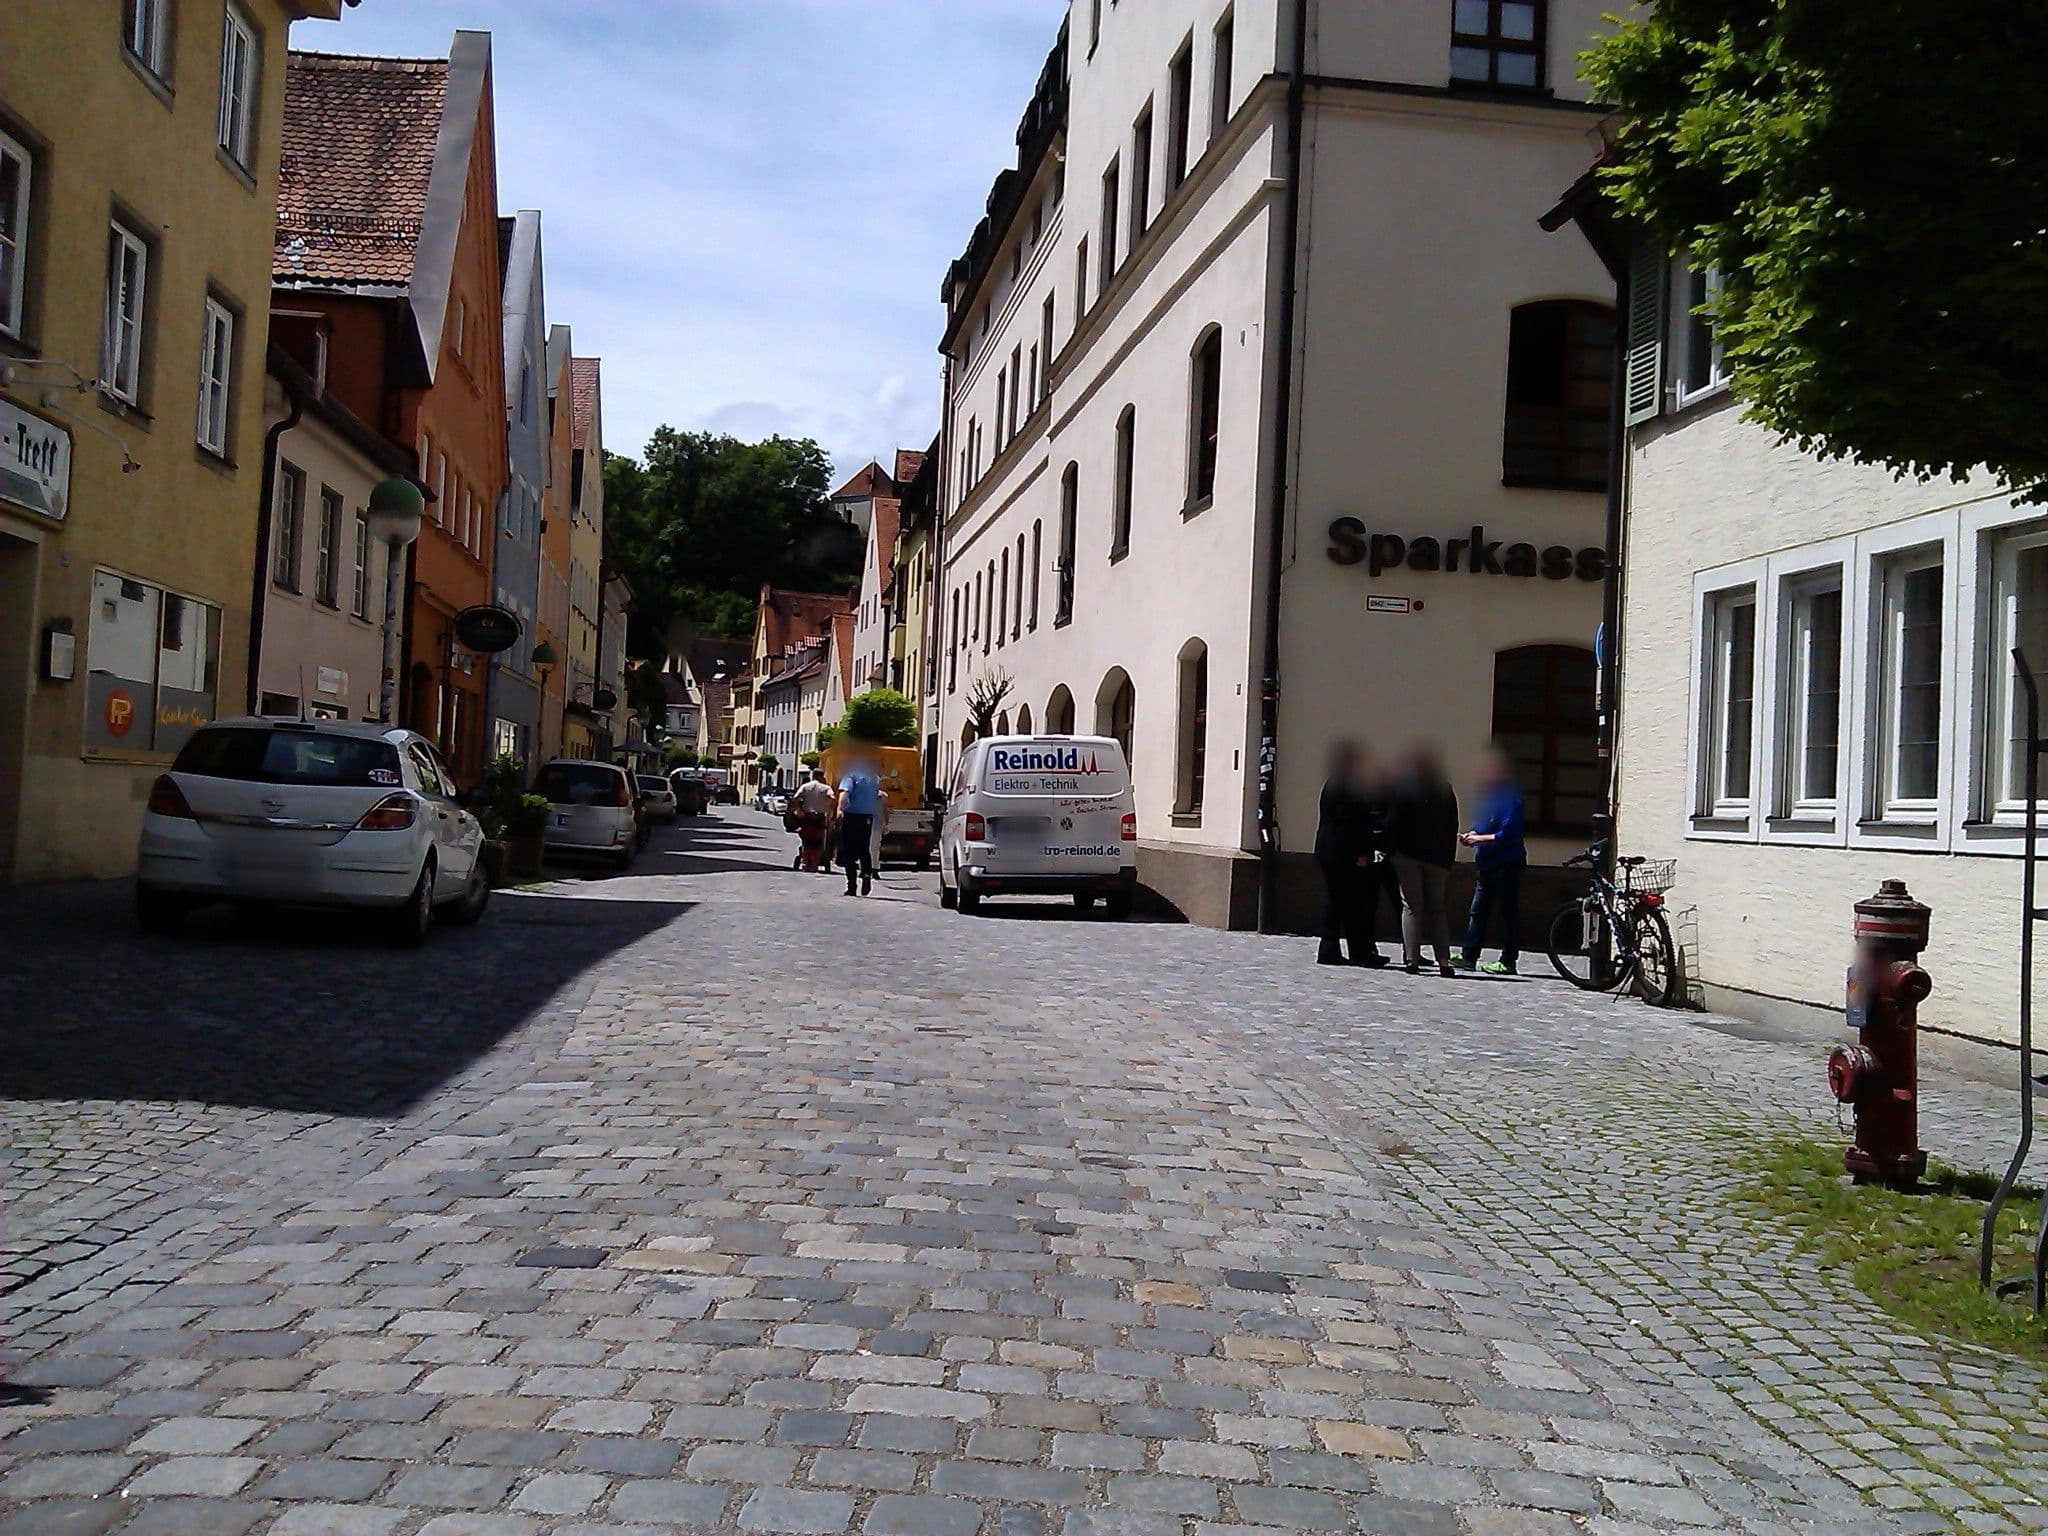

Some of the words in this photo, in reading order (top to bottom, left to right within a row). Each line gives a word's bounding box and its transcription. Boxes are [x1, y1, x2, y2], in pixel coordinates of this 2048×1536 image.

[1326, 516, 1607, 582] Sparkass
[994, 747, 1078, 770] Reinold
[995, 780, 1030, 790] Elektro
[1040, 779, 1079, 790] Technik
